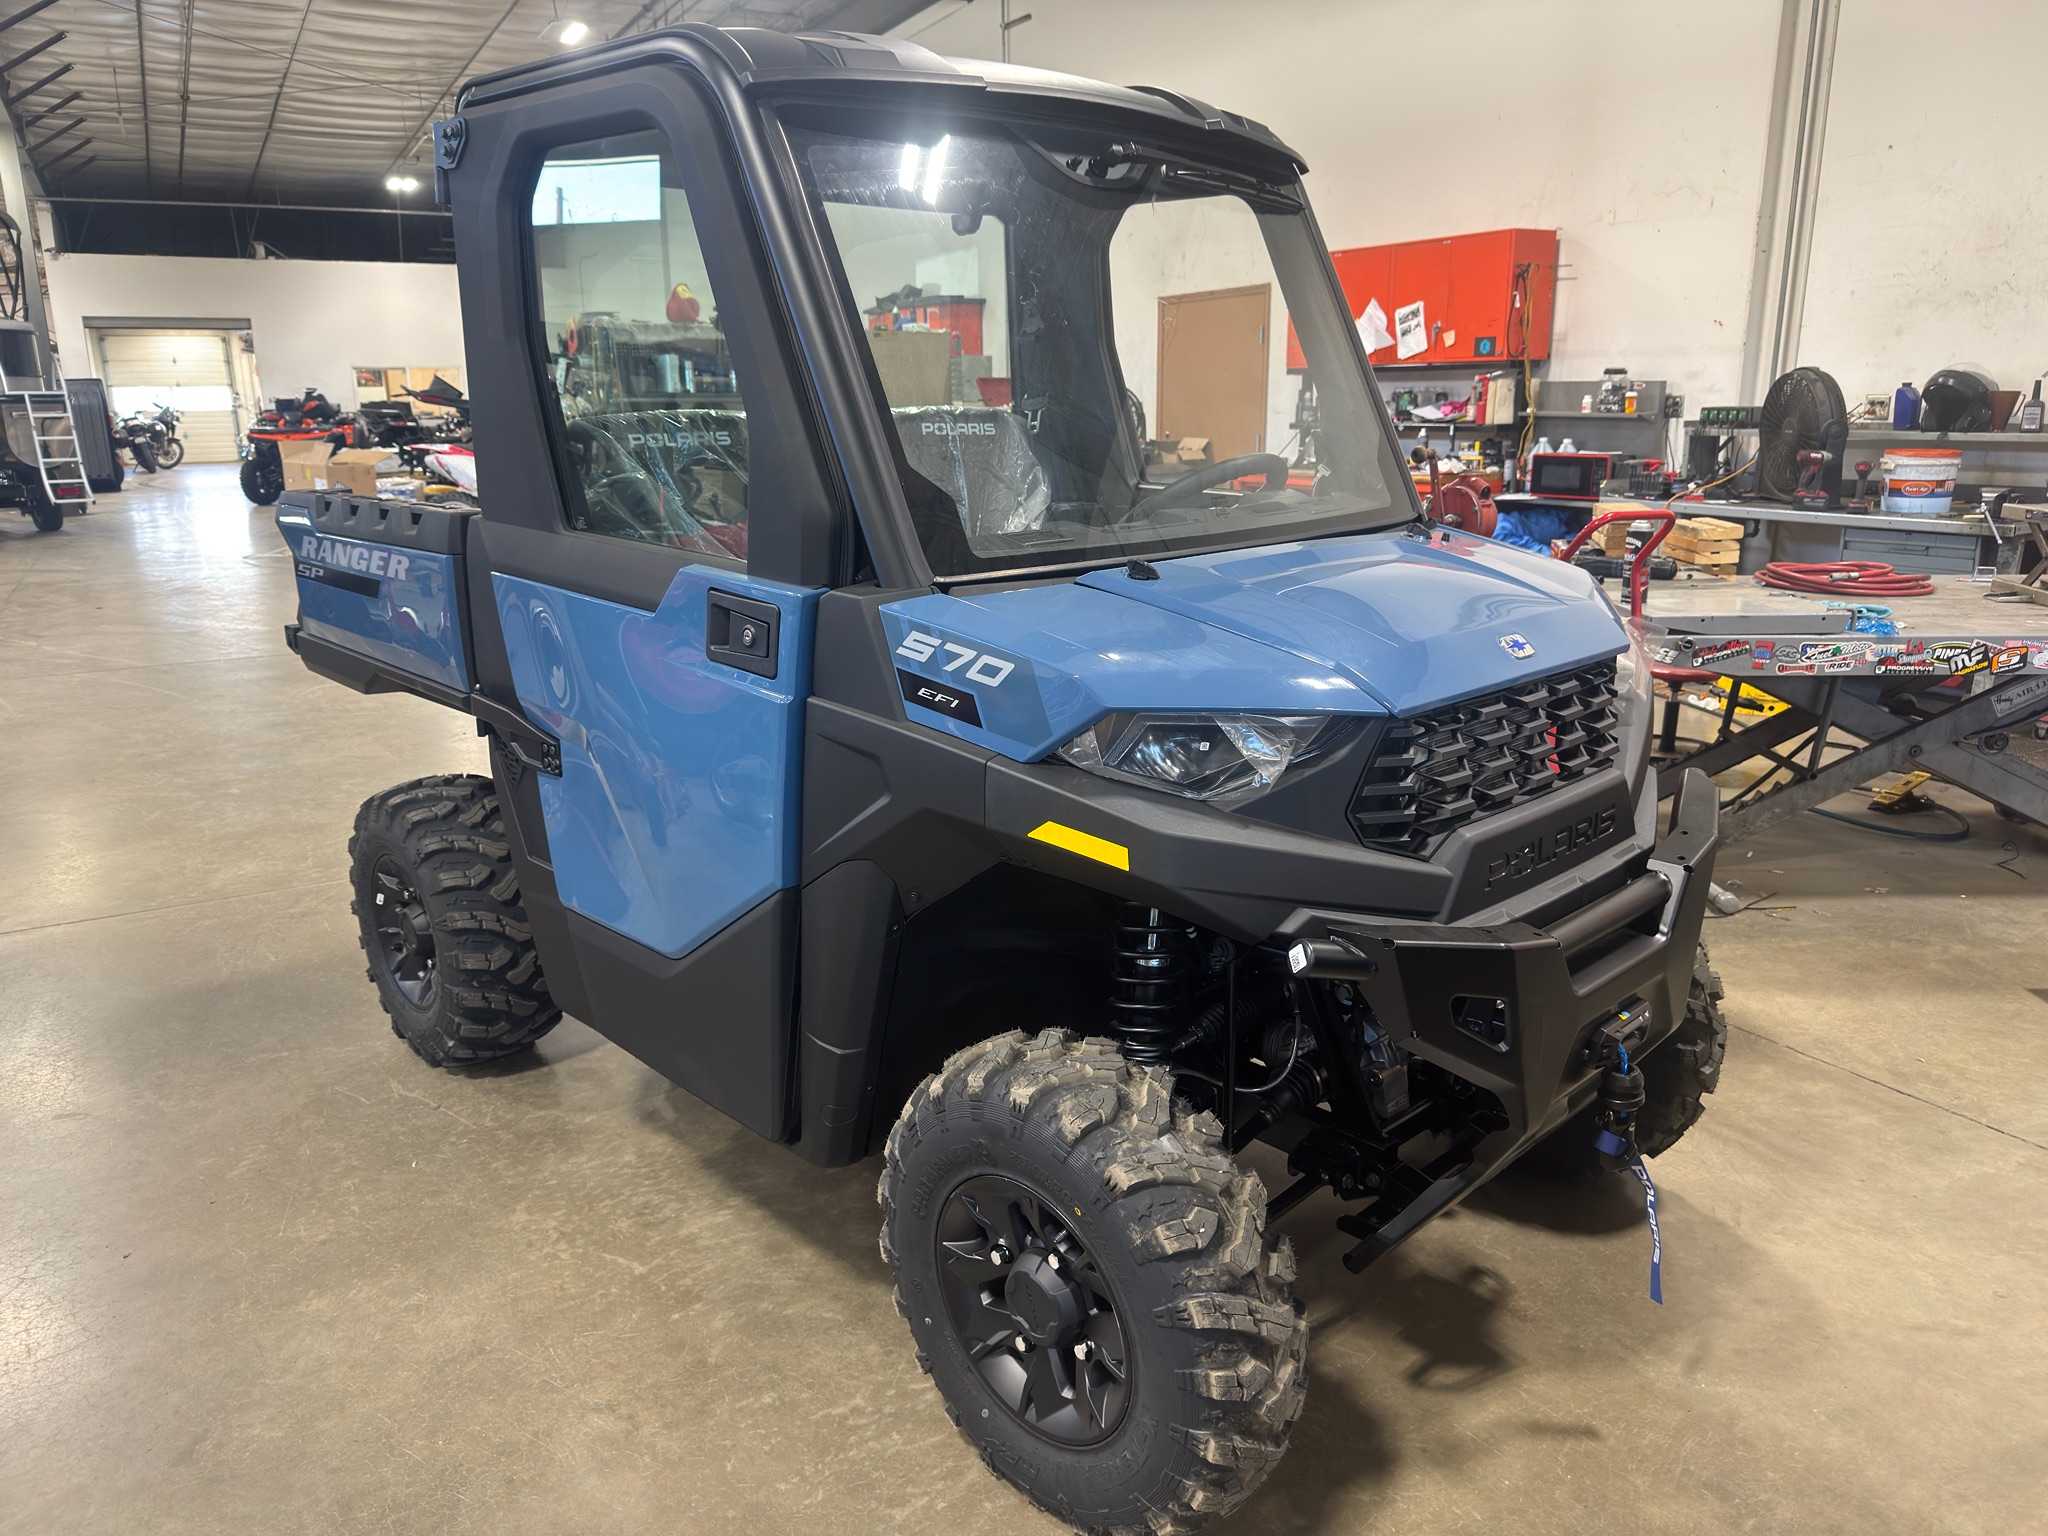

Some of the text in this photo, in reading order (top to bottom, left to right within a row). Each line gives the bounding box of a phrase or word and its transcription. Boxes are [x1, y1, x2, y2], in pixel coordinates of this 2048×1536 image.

[921, 422, 996, 436] POLARIS
[627, 430, 732, 449] POLARIS
[300, 535, 410, 581] RANGER
[297, 563, 324, 579] SP
[1840, 641, 1870, 655] Moto
[1905, 638, 1925, 654] LA
[896, 630, 1015, 687] 570
[917, 687, 960, 708] EFI
[1483, 804, 1617, 891] POLARIS
[1630, 1165, 1660, 1264] POLARIS
